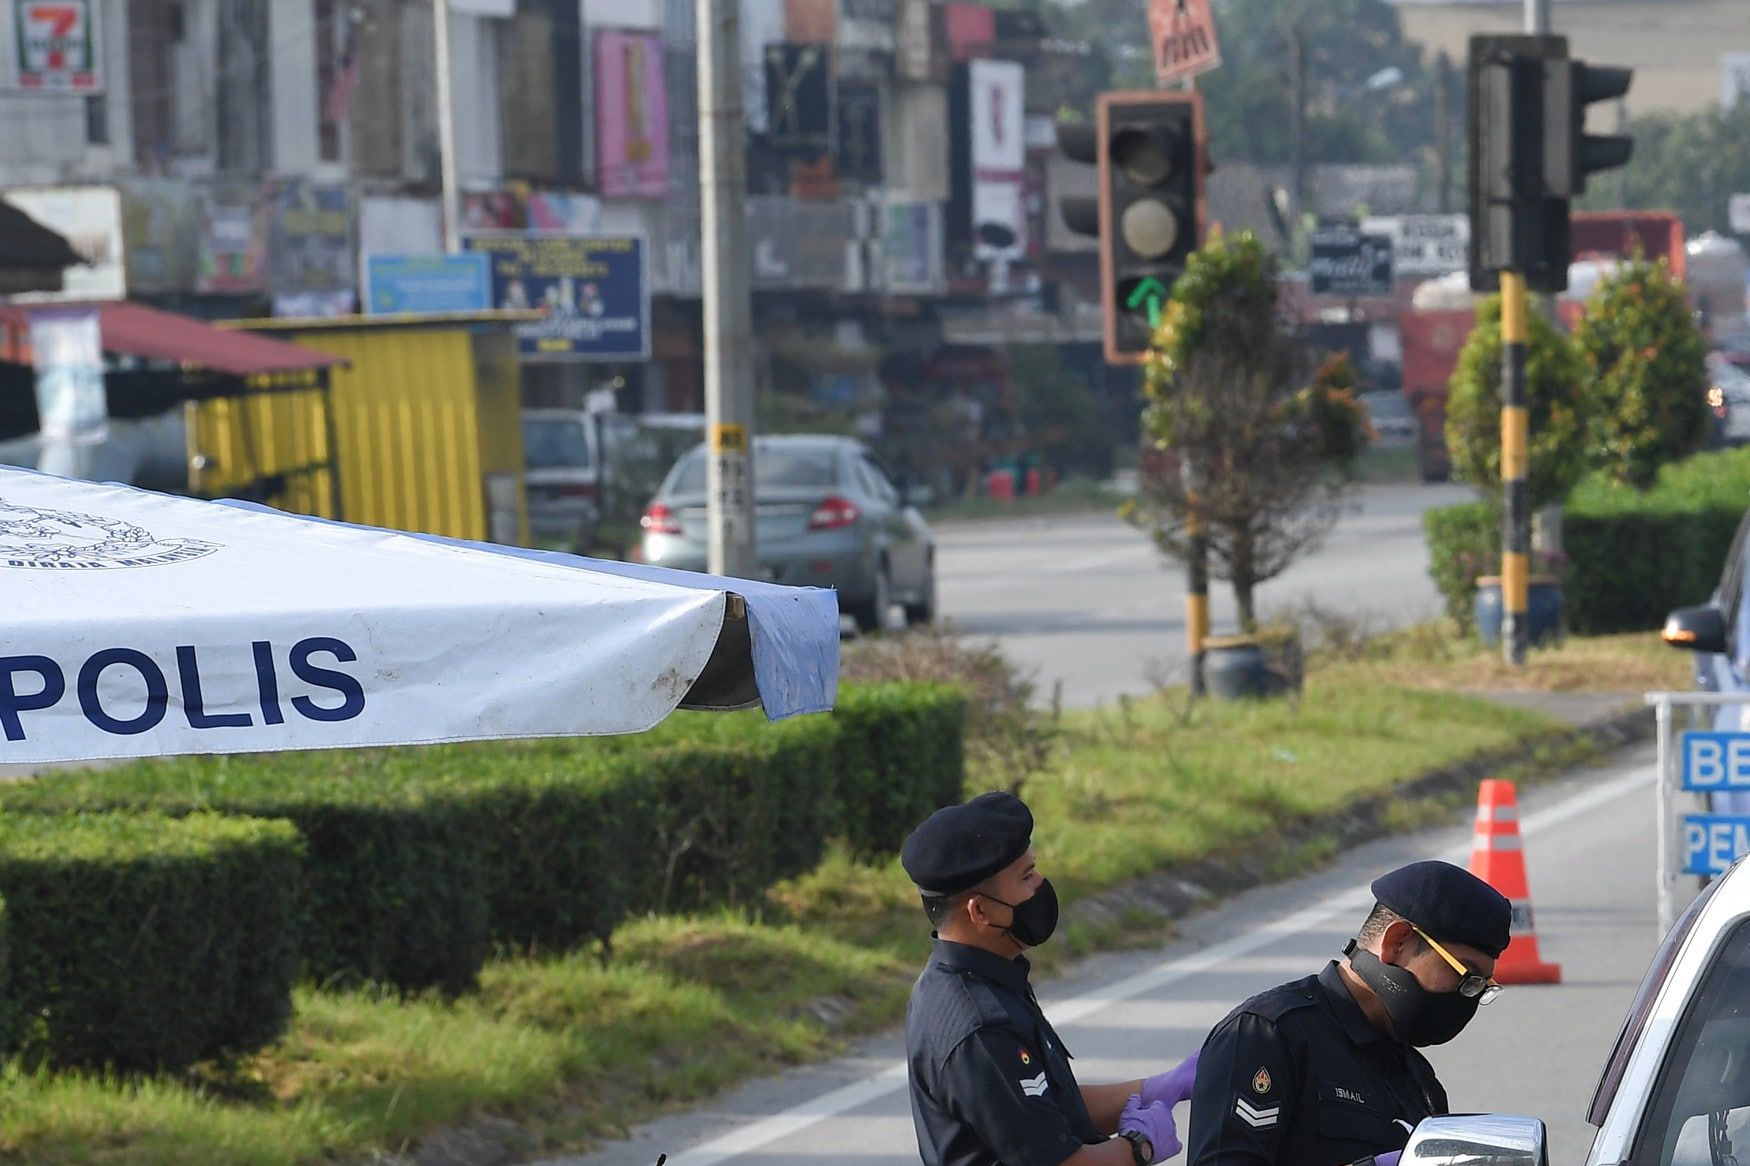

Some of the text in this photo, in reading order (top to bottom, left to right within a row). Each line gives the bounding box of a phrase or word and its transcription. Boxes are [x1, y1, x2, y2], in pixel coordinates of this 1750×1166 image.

[8, 560, 107, 568] DIRAJA
[0, 636, 366, 742] POLIS
[1335, 1087, 1365, 1103] ISMAIL
